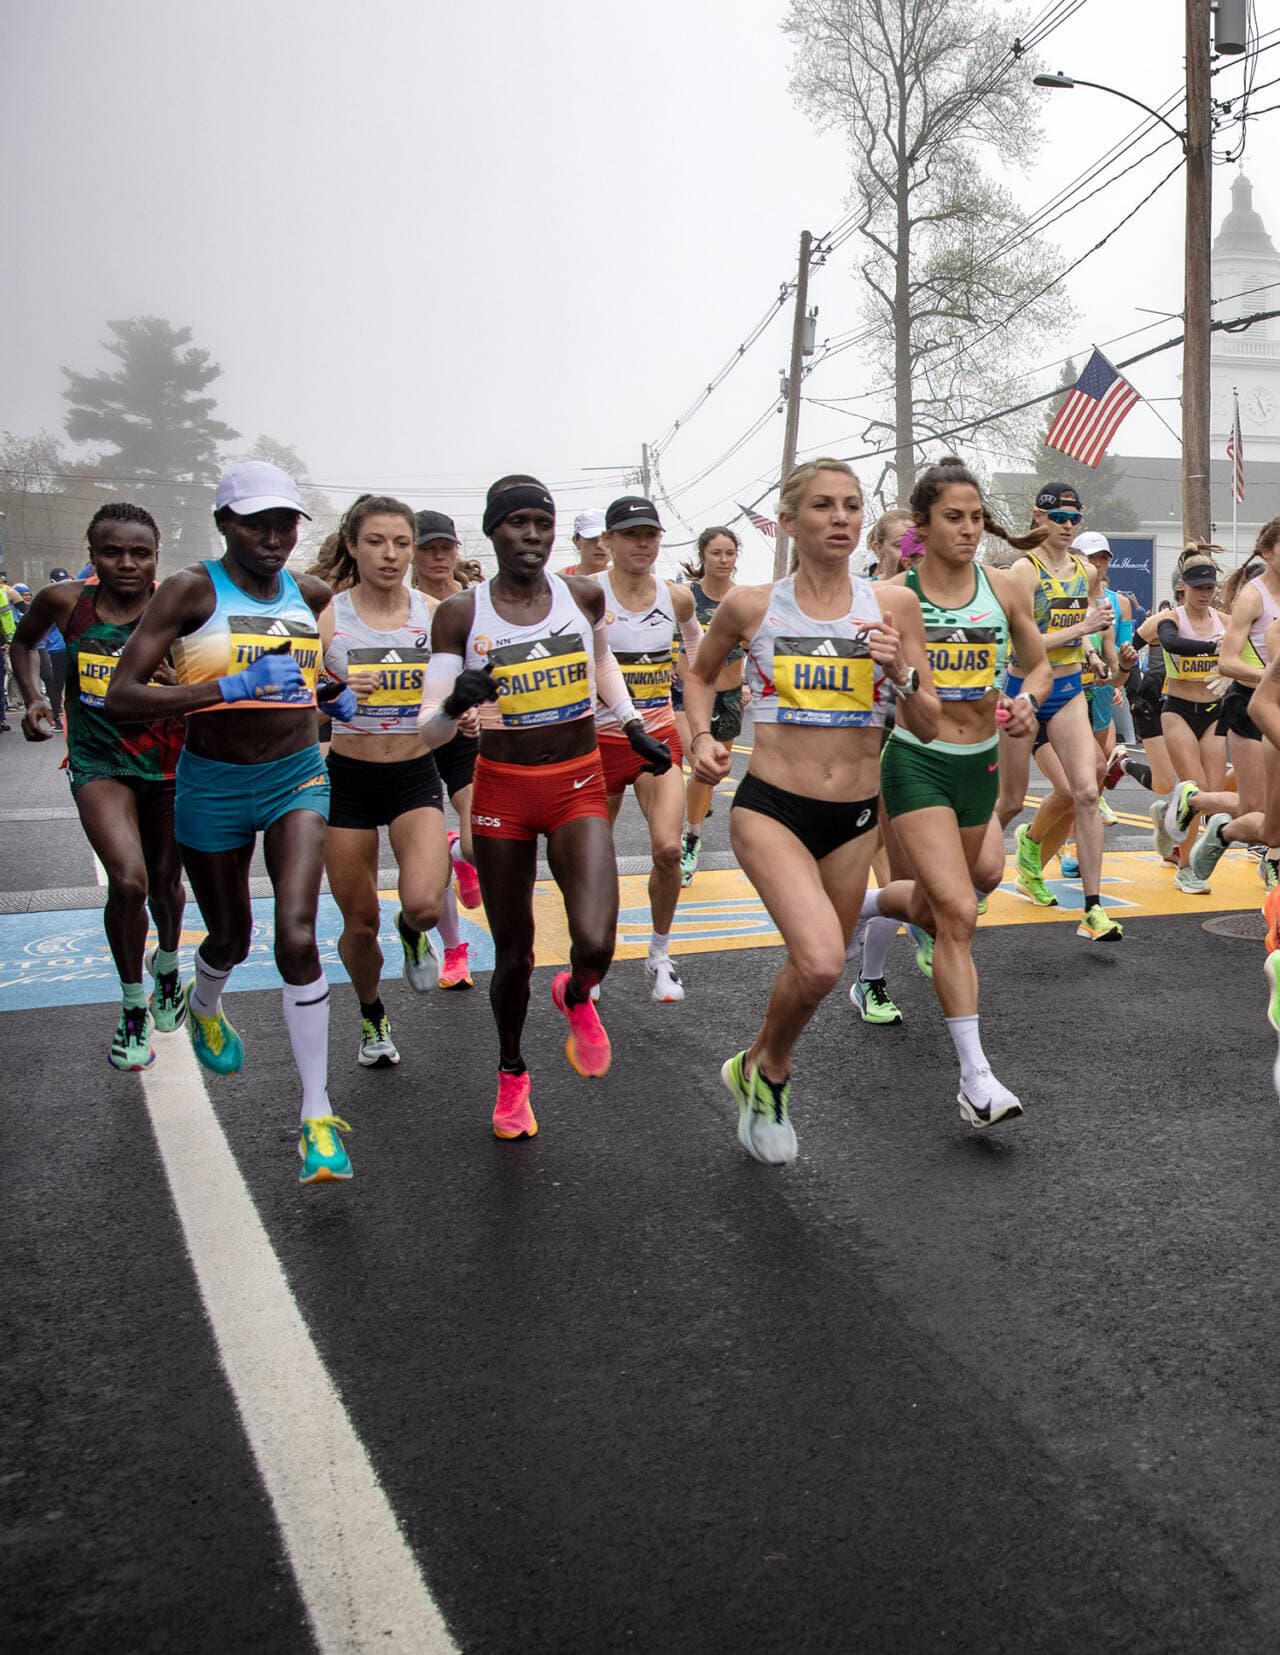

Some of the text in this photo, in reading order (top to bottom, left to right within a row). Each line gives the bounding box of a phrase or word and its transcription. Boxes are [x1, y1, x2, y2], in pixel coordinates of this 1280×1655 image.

[1121, 557, 1150, 573] Hancock
[1051, 613, 1083, 627] COOG
[925, 649, 989, 671] ROJAS
[379, 669, 424, 690] ATES
[497, 662, 588, 696] SALPETER
[794, 663, 854, 692] HALL
